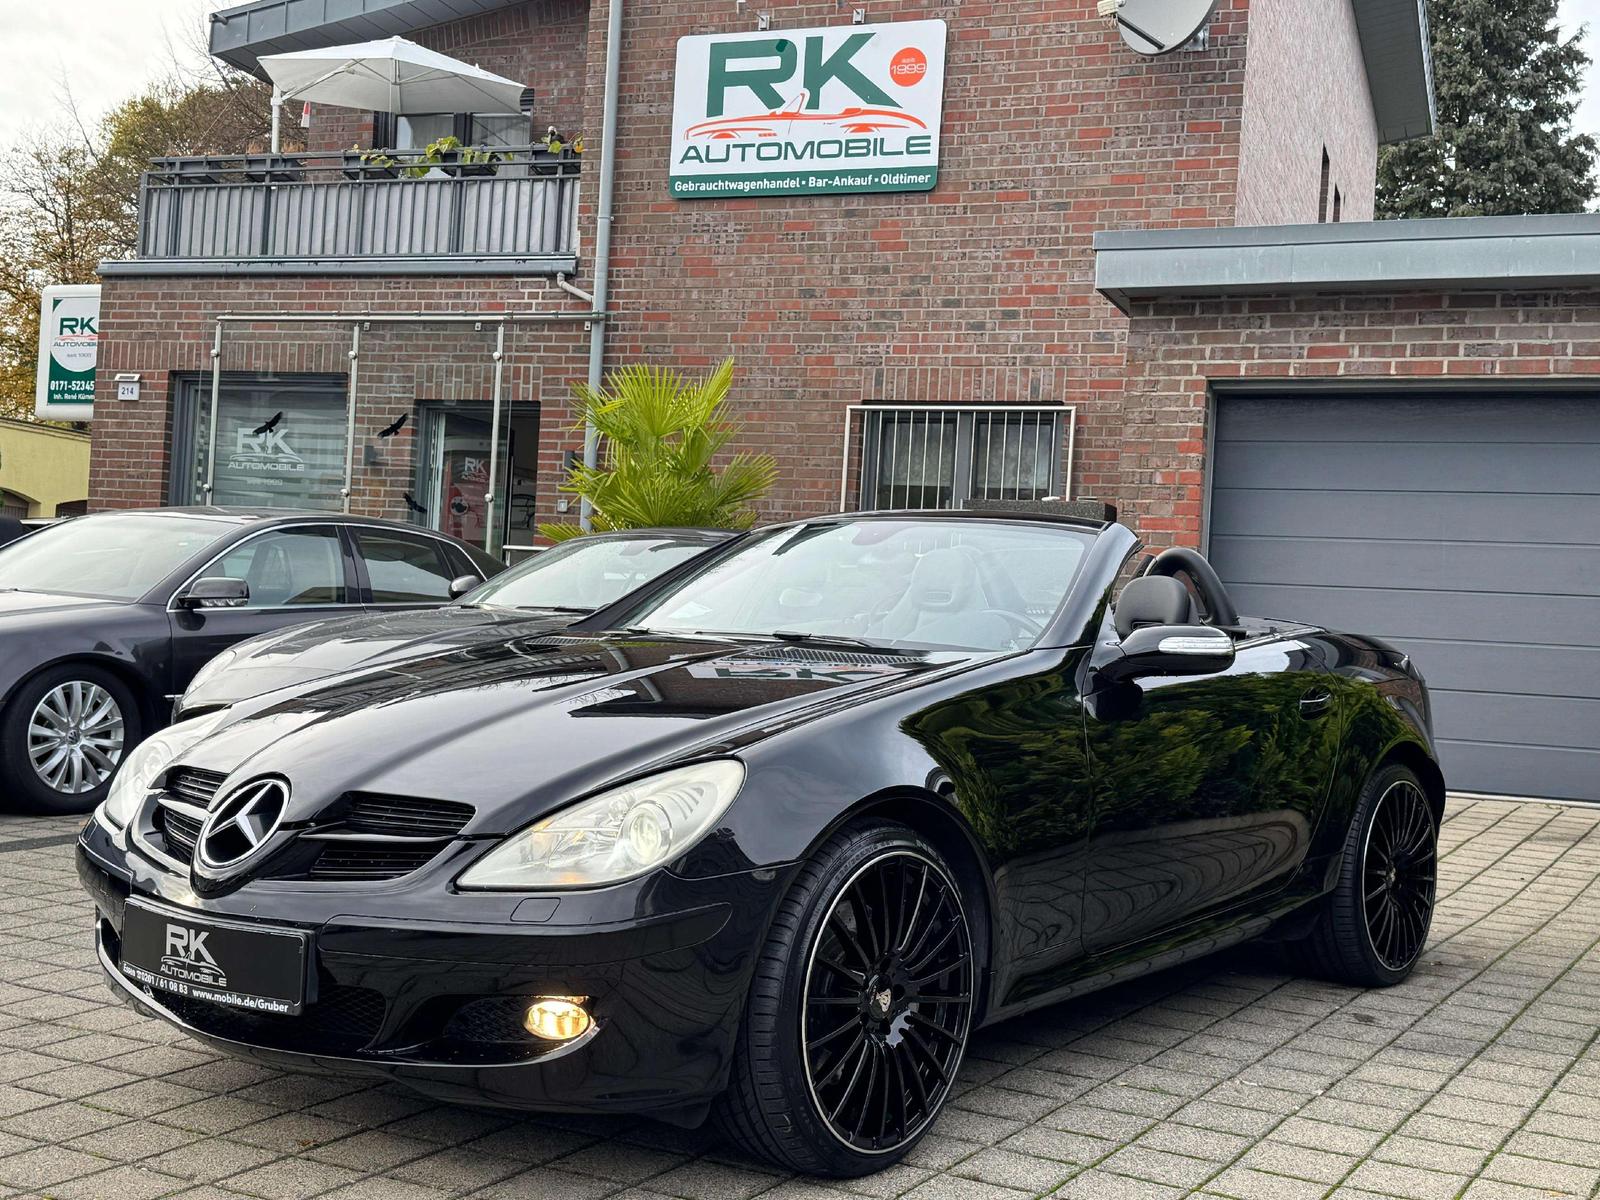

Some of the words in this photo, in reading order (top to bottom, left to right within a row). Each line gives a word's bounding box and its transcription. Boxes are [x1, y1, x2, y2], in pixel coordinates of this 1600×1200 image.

[706, 32, 903, 118] RK
[891, 63, 926, 75] 1999
[679, 135, 932, 164] AUTOMOBILE
[674, 177, 801, 192] Gebrauchtwagenhandel
[808, 174, 873, 188] Bar-Ankauf
[880, 173, 931, 185] Oldtimer
[59, 316, 98, 336] RK
[121, 386, 134, 395] 214
[236, 427, 297, 456] RK
[228, 461, 305, 472] AUTOMOBILE
[464, 456, 488, 474] RK
[166, 923, 219, 966] RK
[160, 963, 227, 987] AUTOMOBILE
[160, 978, 168, 989] 61
[169, 981, 178, 991] 08
[179, 983, 188, 995] 83
[192, 989, 289, 1013] www.mobile.de/Gruber
